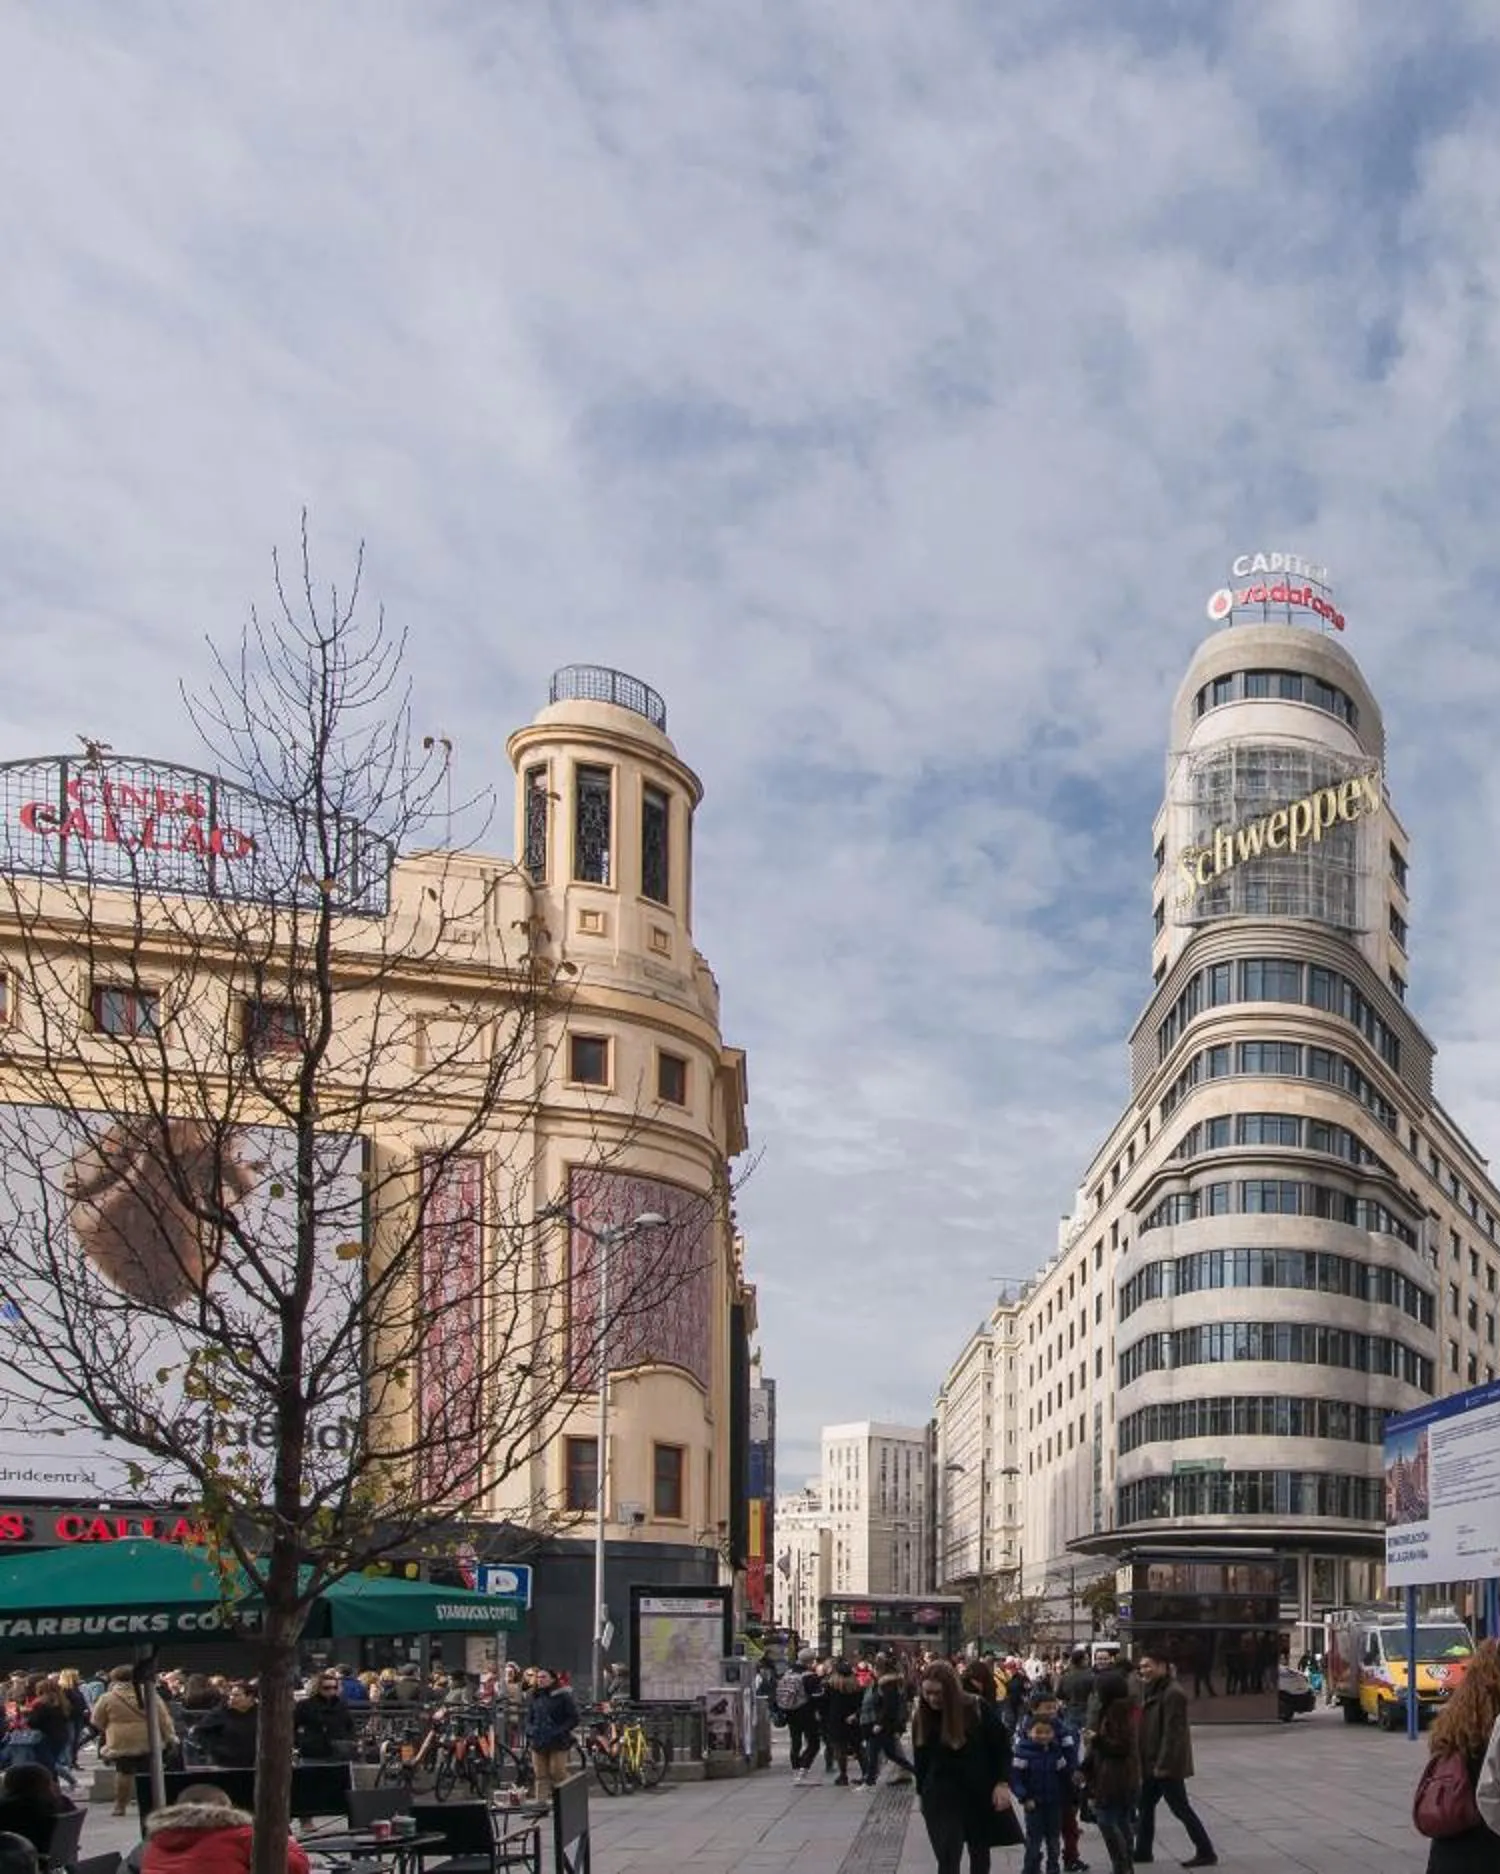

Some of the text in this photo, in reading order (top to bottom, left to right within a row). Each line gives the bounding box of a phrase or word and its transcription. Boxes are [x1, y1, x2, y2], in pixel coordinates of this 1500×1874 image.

[1234, 581, 1346, 632] vodafone
[66, 778, 207, 819] CINES
[19, 799, 252, 861] CALLAO
[1178, 766, 1380, 898] Schweppes
[0, 1467, 95, 1484] dridcentral
[486, 1569, 519, 1595] P
[0, 1612, 169, 1637] TARBUCKS
